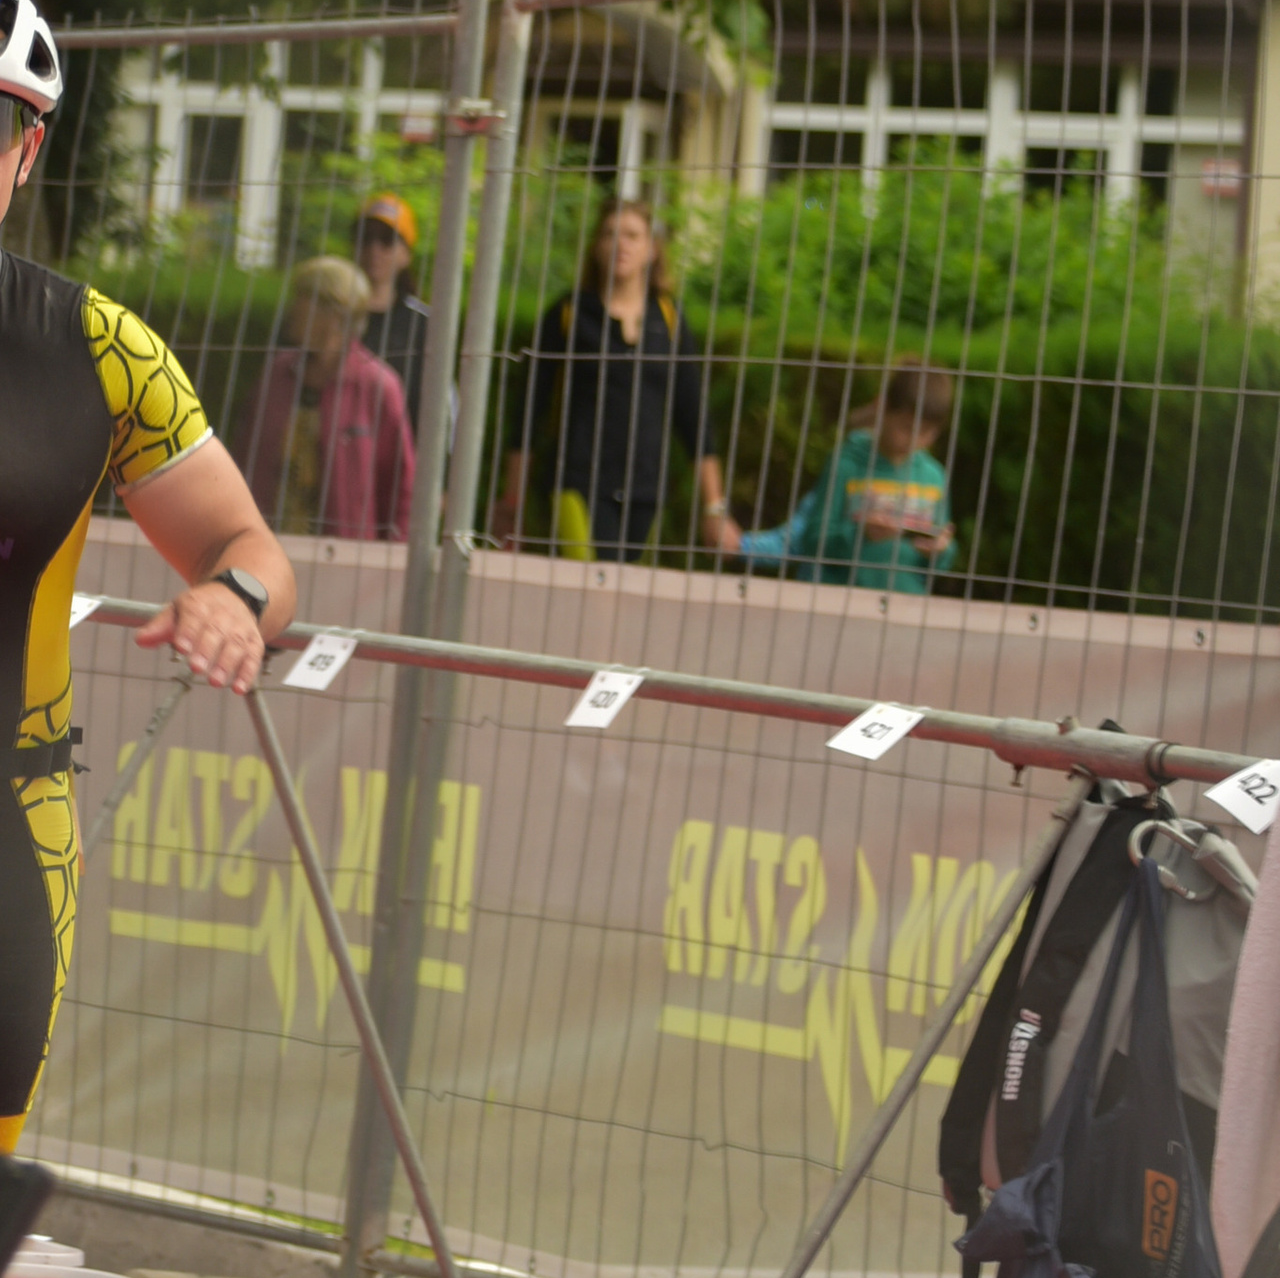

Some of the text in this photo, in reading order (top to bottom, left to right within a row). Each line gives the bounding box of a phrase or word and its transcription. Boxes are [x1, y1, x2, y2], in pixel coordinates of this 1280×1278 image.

[859, 720, 894, 742] 421
[1238, 772, 1278, 806] 422
[1001, 1007, 1043, 1102] IRONSTAR
[1151, 1180, 1172, 1256] PRO
